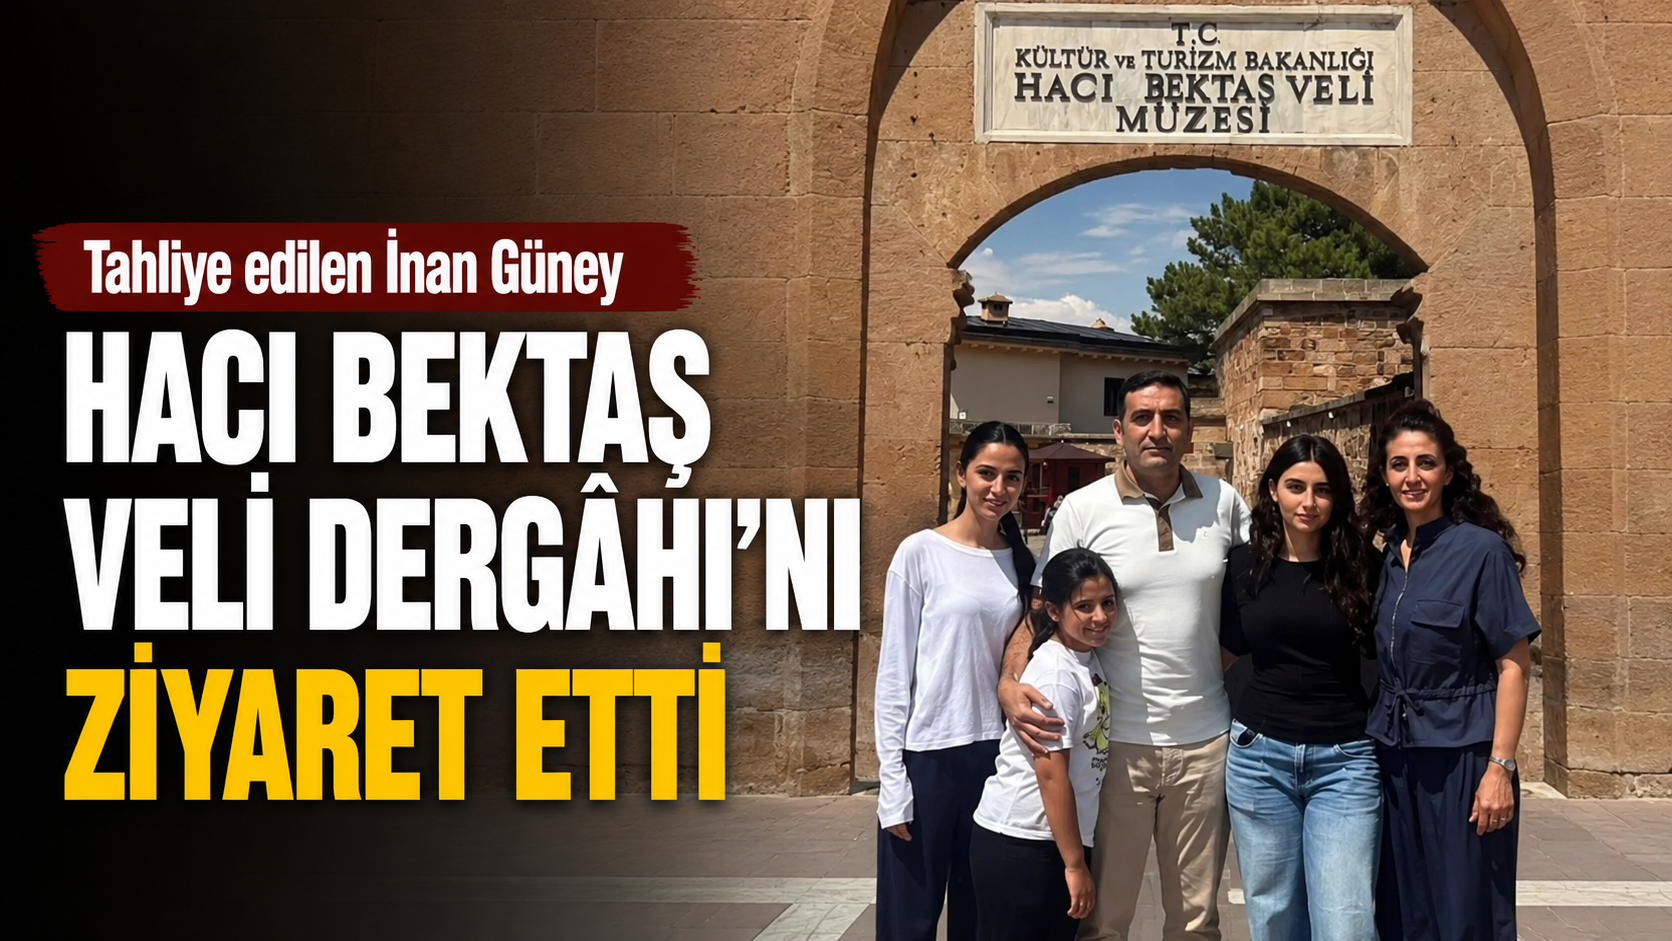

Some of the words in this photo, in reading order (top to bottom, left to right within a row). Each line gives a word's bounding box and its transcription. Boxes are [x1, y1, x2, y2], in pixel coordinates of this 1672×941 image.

[1015, 45, 1110, 69] KÜLTÜR
[1114, 55, 1136, 70] VE
[1141, 45, 1237, 71] TURİZM
[1244, 47, 1375, 71] BAKANLIĞI
[1014, 72, 1114, 103] HACI
[1285, 70, 1375, 106] VELİ
[1115, 101, 1270, 134] MÜZESİ
